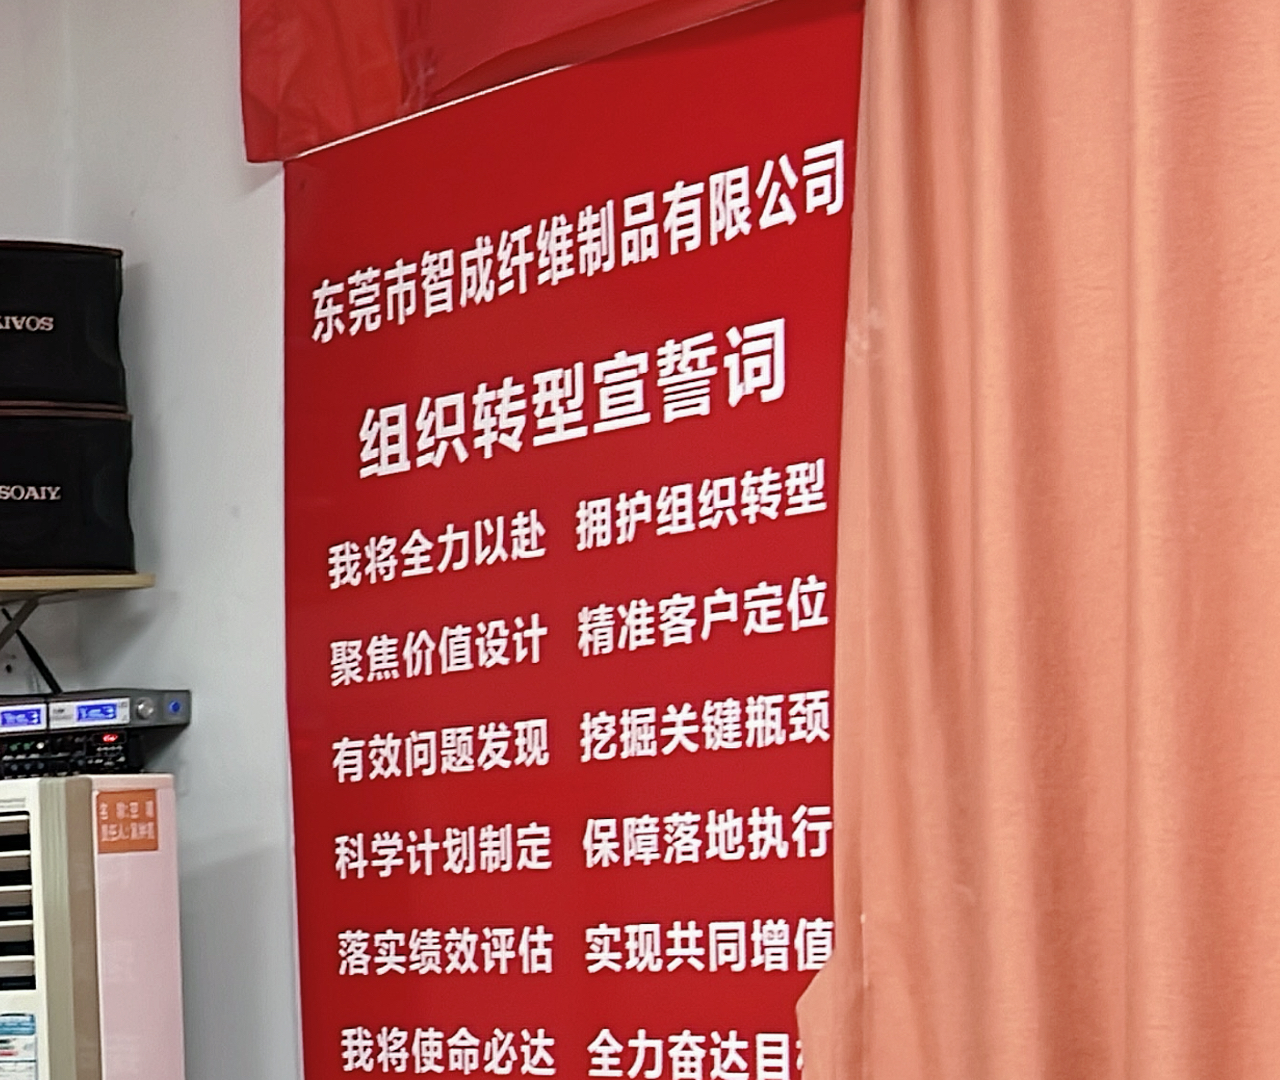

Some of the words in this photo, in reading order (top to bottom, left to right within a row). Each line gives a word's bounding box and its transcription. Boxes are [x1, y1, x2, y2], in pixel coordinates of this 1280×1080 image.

[312, 139, 845, 343] 东莞市智成纤维制品有限公司
[359, 318, 786, 479] 组织转型宣誓词
[328, 509, 546, 590] 我将全力以赴
[576, 458, 827, 552] 拥护组织转型
[330, 616, 548, 687] 聚焦价值设计
[578, 575, 829, 657] 精准客户定位
[332, 719, 549, 783] 有效问题发现
[580, 690, 831, 763] 挖掘关键瓶颈
[335, 822, 552, 879] 科学计划制定
[583, 805, 833, 868] 保障落地执行
[338, 925, 554, 976] 落实绩效评估
[585, 918, 834, 972] 实现共同增值
[341, 1027, 556, 1076] 我将使命必达
